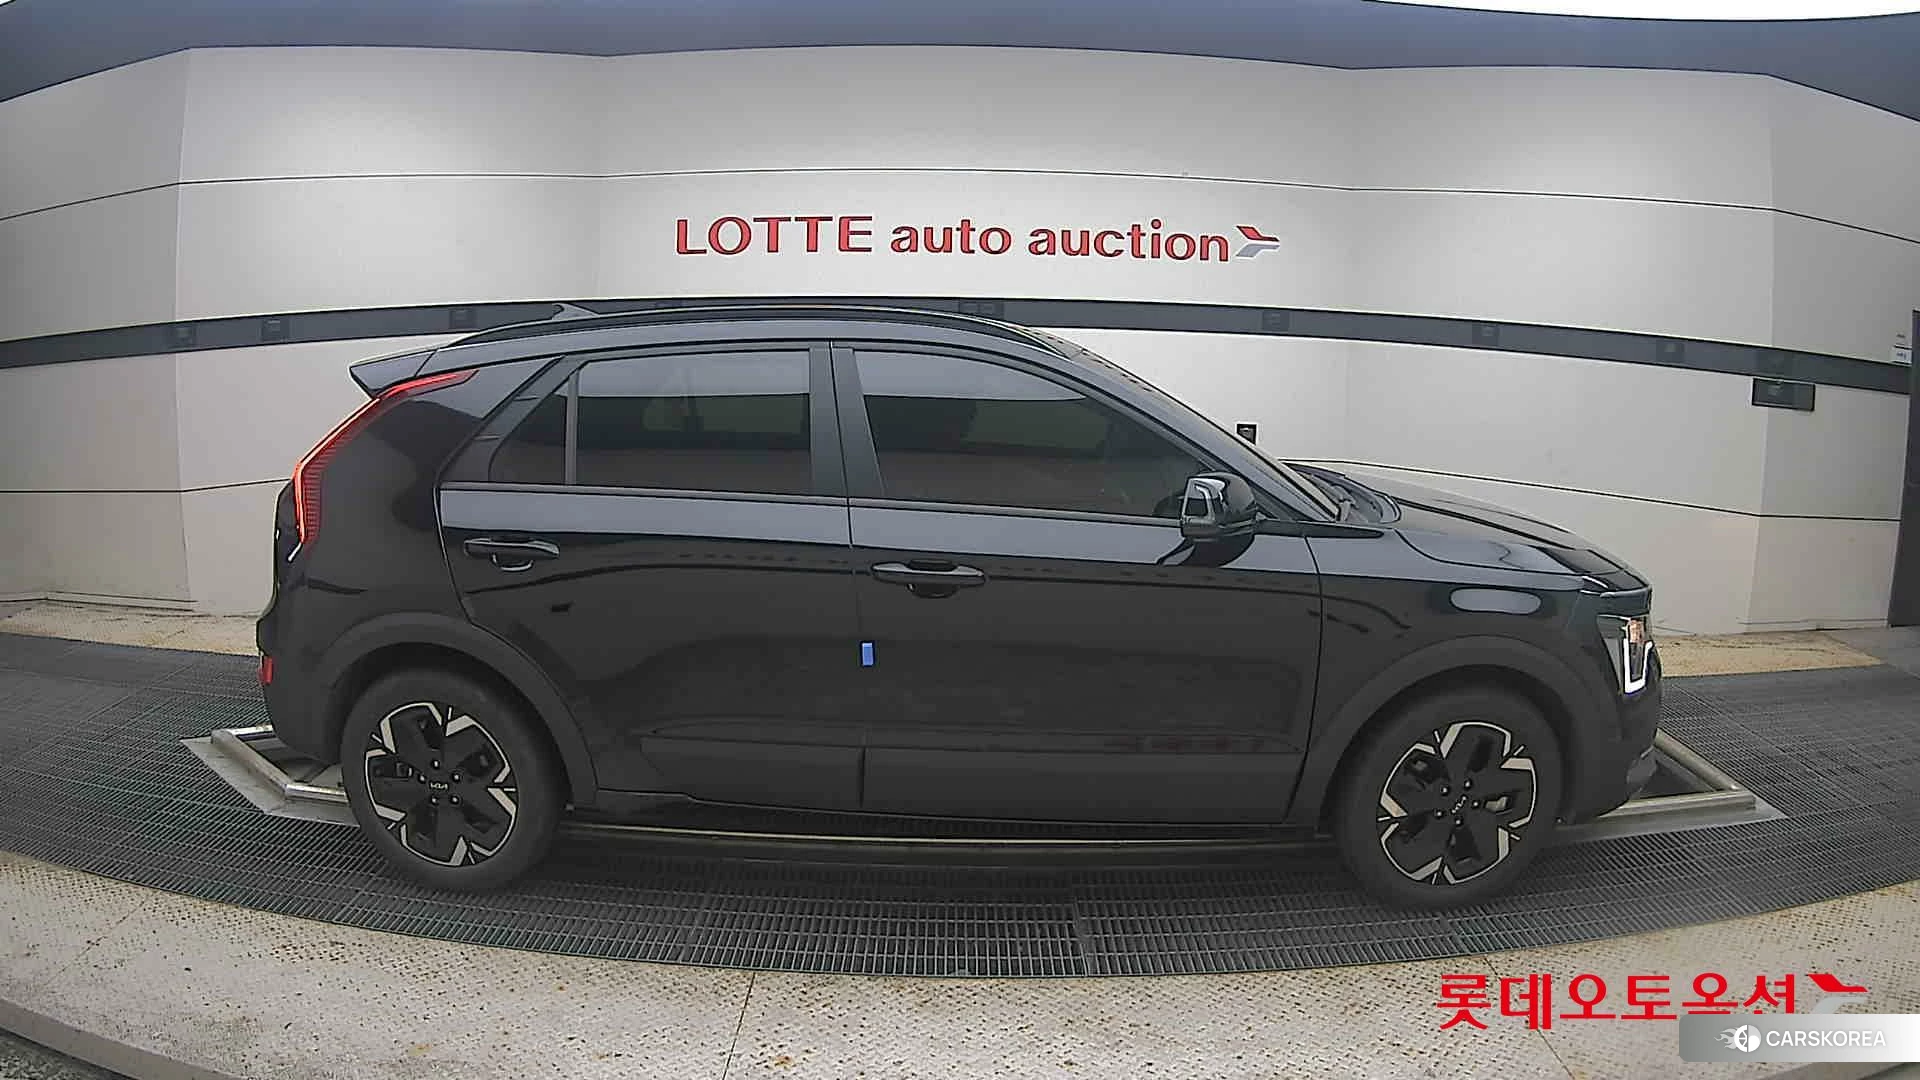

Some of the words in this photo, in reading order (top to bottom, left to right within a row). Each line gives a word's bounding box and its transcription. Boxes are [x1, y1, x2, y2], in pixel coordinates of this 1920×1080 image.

[676, 215, 873, 256] LOTTE
[889, 219, 1013, 255] auto
[1028, 219, 1230, 262] auction
